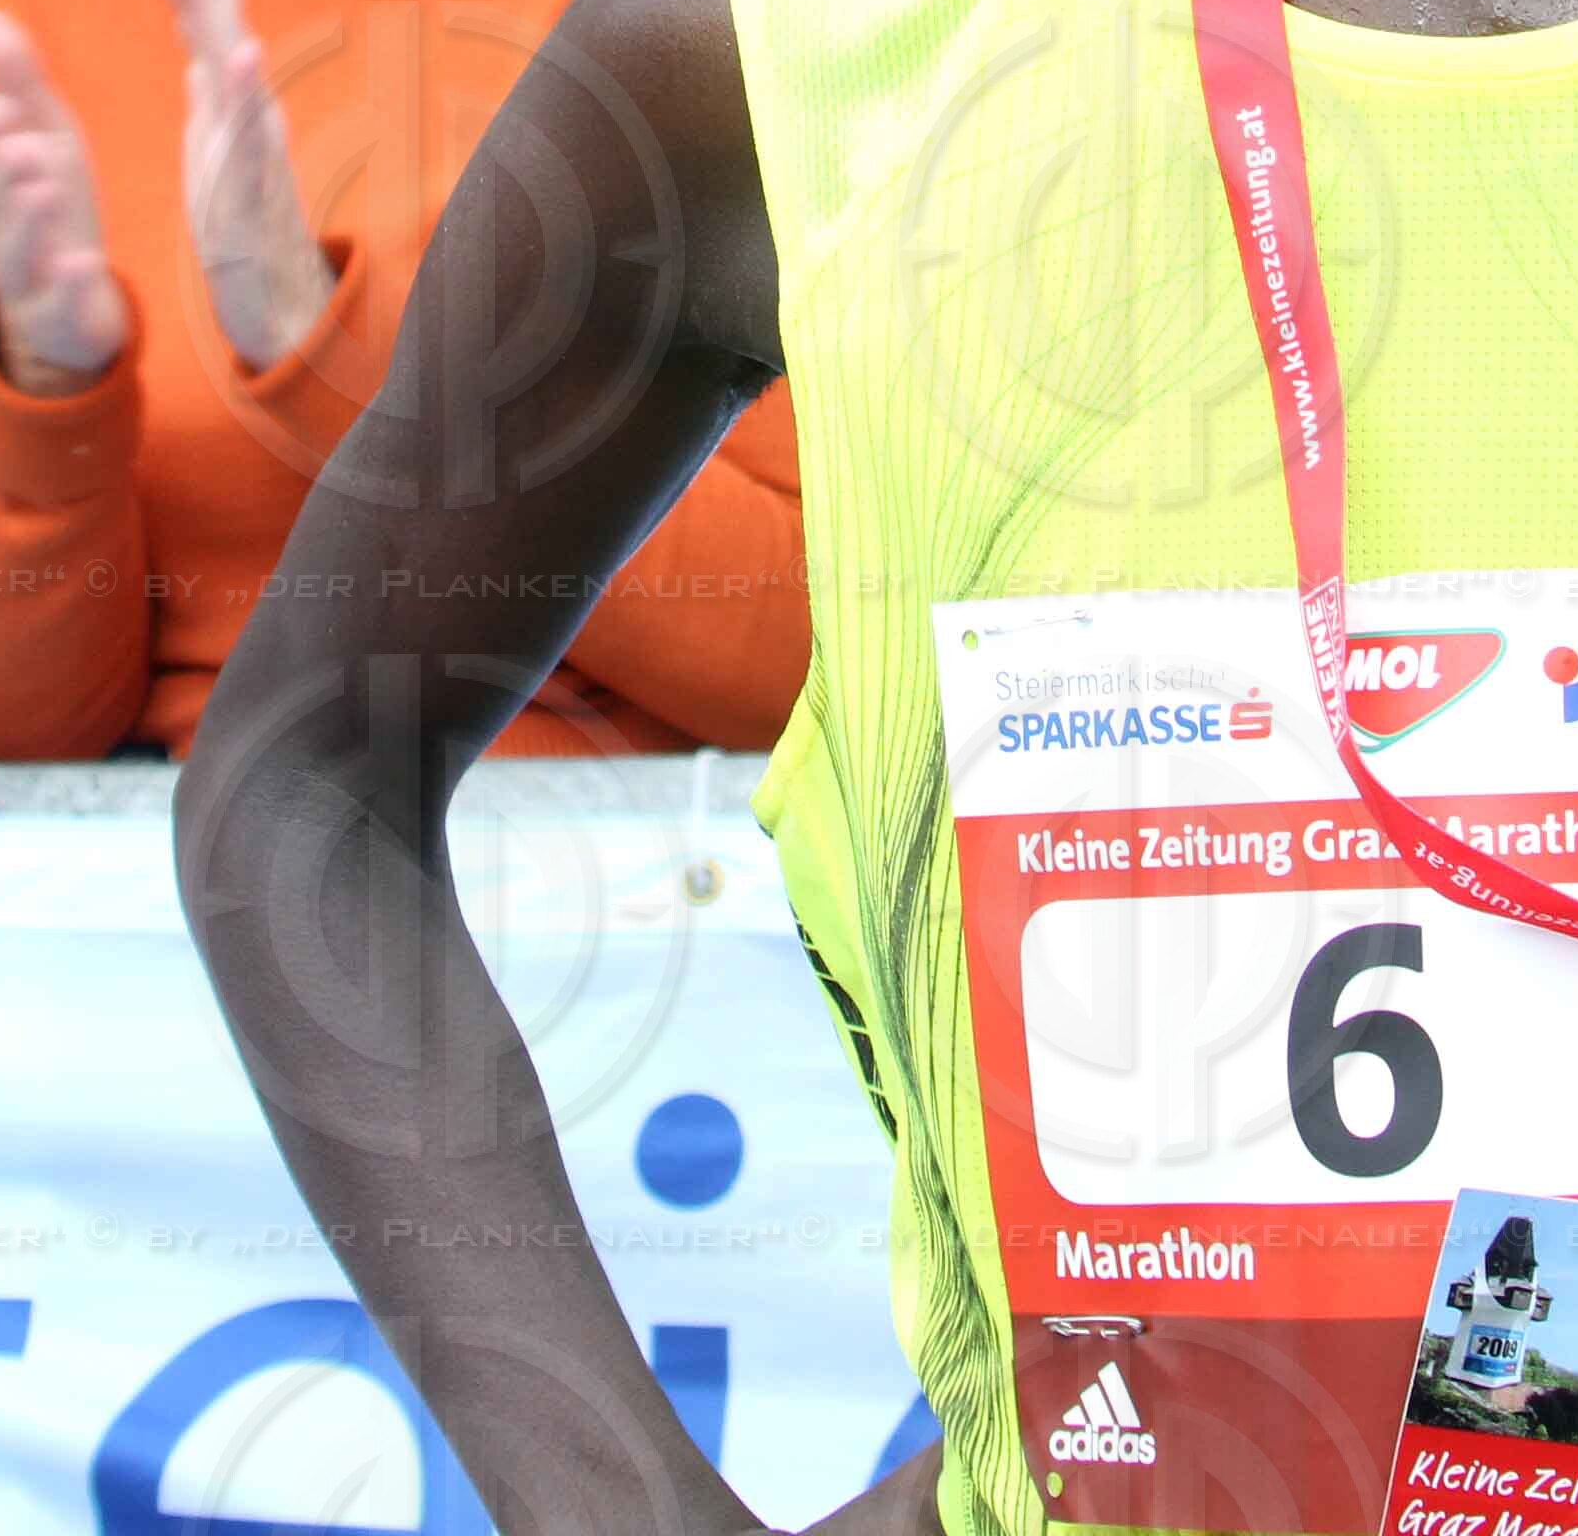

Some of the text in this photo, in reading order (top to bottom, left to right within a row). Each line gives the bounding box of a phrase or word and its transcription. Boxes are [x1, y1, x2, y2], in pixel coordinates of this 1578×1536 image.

[1235, 104, 1321, 470] www.kleinezeitung.at
[1344, 643, 1440, 692] MOL
[998, 703, 1223, 753] SPARKASSE
[1017, 828, 1131, 874] Kleine
[1137, 823, 1293, 877] Zeitung
[1286, 921, 1445, 1180] 6
[1054, 1228, 1257, 1282] Marathon
[1476, 1335, 1519, 1360] 2009
[1048, 1424, 1157, 1464] adidas
[1407, 1450, 1520, 1497] Kleine
